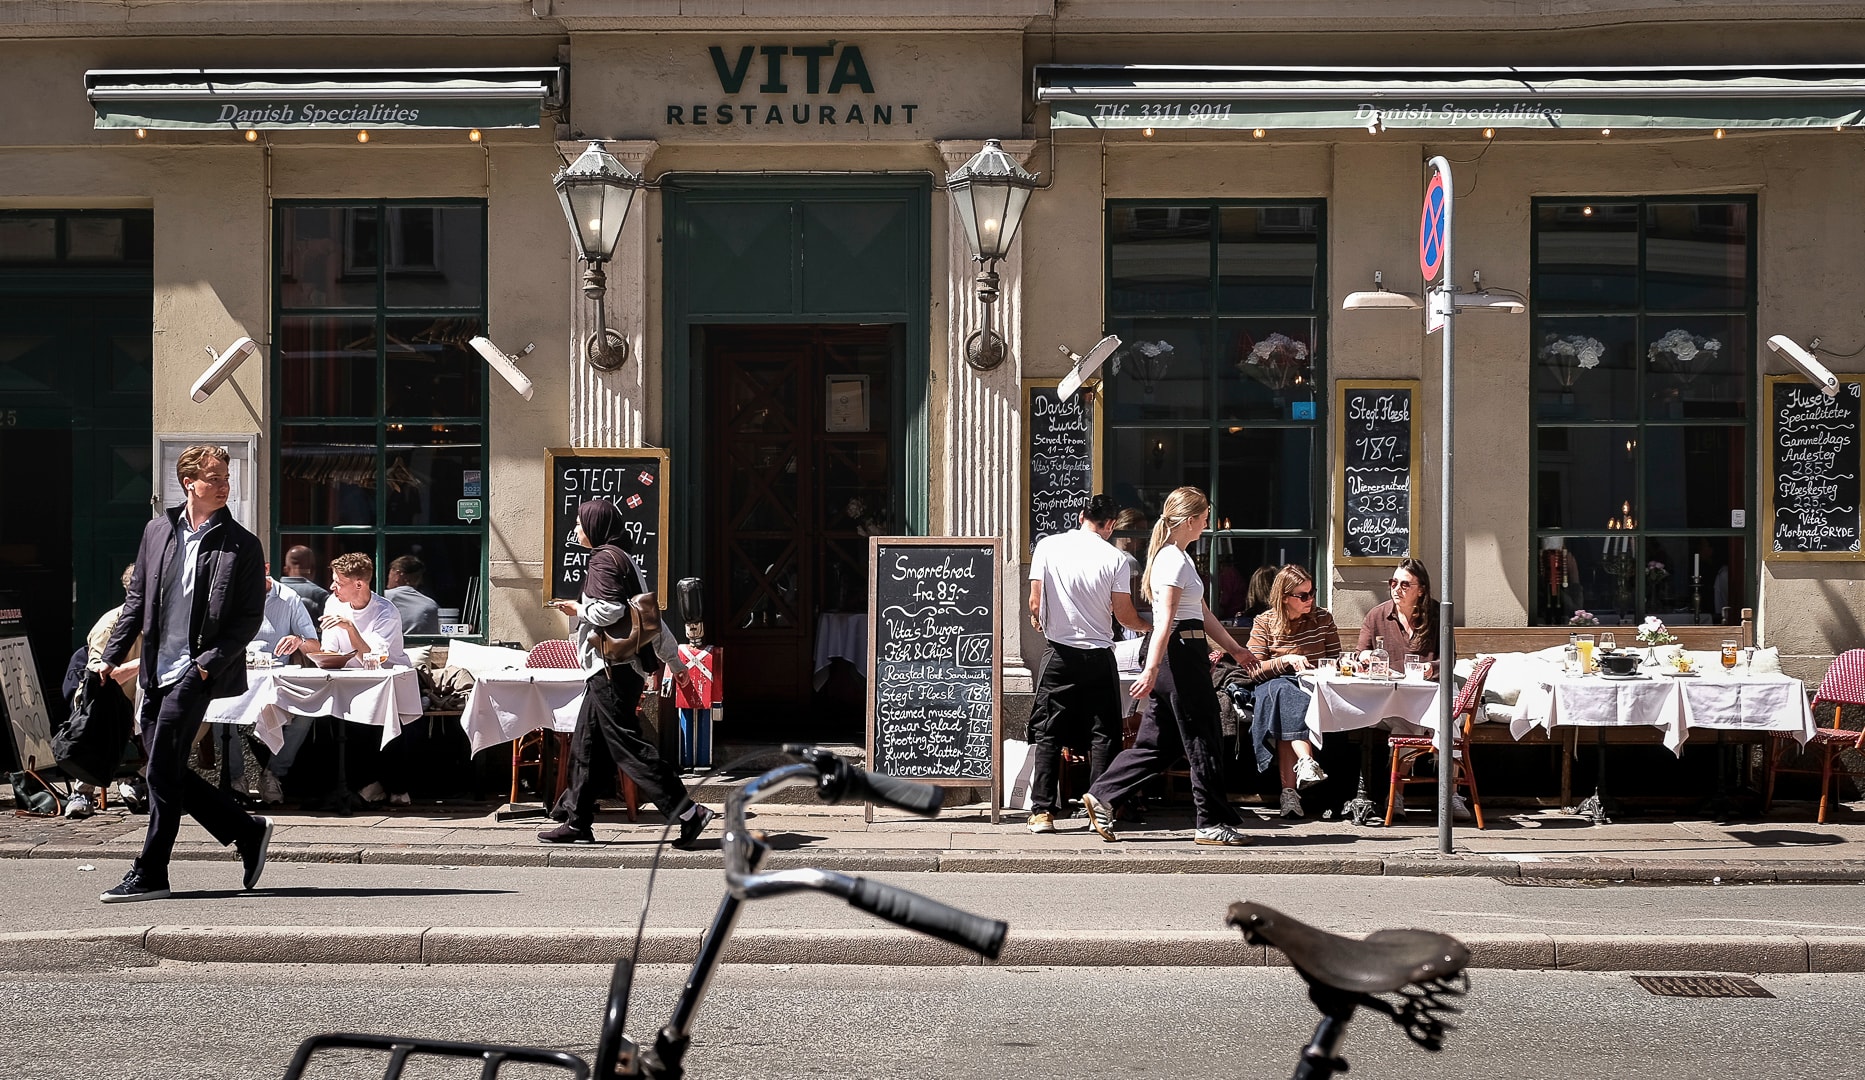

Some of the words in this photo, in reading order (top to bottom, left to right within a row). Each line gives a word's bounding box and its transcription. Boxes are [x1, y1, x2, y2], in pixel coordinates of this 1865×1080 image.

[708, 45, 875, 94] VITA
[216, 103, 294, 122] Danish
[300, 103, 419, 125] Specialities
[667, 104, 918, 125] RESTAURANT
[1095, 103, 1130, 121] Tlf.
[1138, 103, 1181, 121] 3311
[1187, 103, 1232, 121] 8011
[1353, 103, 1433, 121] Danish
[1439, 103, 1562, 126] Specialities
[1048, 415, 1088, 432] Lunch
[1350, 396, 1379, 430] Stegt
[1779, 403, 1851, 428] Specialiteter
[1033, 433, 1062, 445] Served
[1063, 433, 1086, 446] from:
[1780, 431, 1851, 452] Gammeldags
[1781, 446, 1835, 469] Andesteg
[564, 468, 625, 493] STEGT
[1779, 480, 1838, 501] Flæskesteg
[1799, 512, 1828, 527] Vita's
[1820, 526, 1855, 538] GRYDE
[563, 552, 590, 567] EAT
[892, 555, 975, 581] Smørrebrød
[563, 569, 580, 582] AS
[913, 581, 935, 602] fra
[886, 619, 921, 640] Vita's
[923, 617, 965, 645] Burger
[885, 641, 911, 661] Fish
[922, 642, 953, 664] Chips
[882, 665, 925, 681] Roasted
[882, 685, 914, 707] Stegt
[928, 705, 967, 719] mussels
[921, 718, 962, 731] Salad
[928, 731, 955, 744] Star
[885, 746, 917, 760] Lunch
[923, 745, 963, 757] Platter
